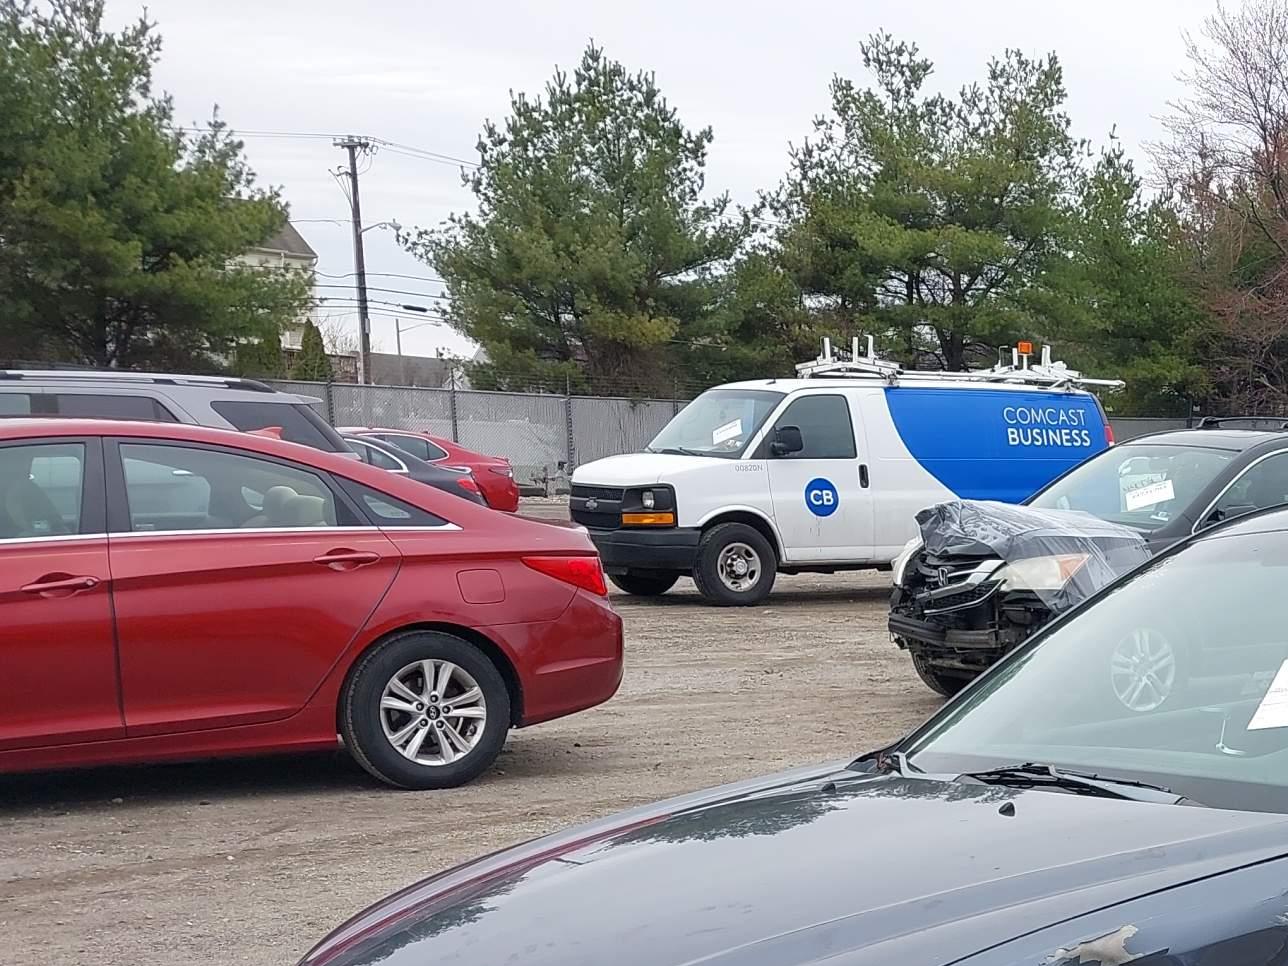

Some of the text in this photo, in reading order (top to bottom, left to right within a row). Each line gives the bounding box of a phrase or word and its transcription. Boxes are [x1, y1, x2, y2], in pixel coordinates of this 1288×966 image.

[1003, 406, 1086, 426] COMCAST
[1007, 427, 1091, 447] BUSINESS
[810, 489, 834, 506] CB
